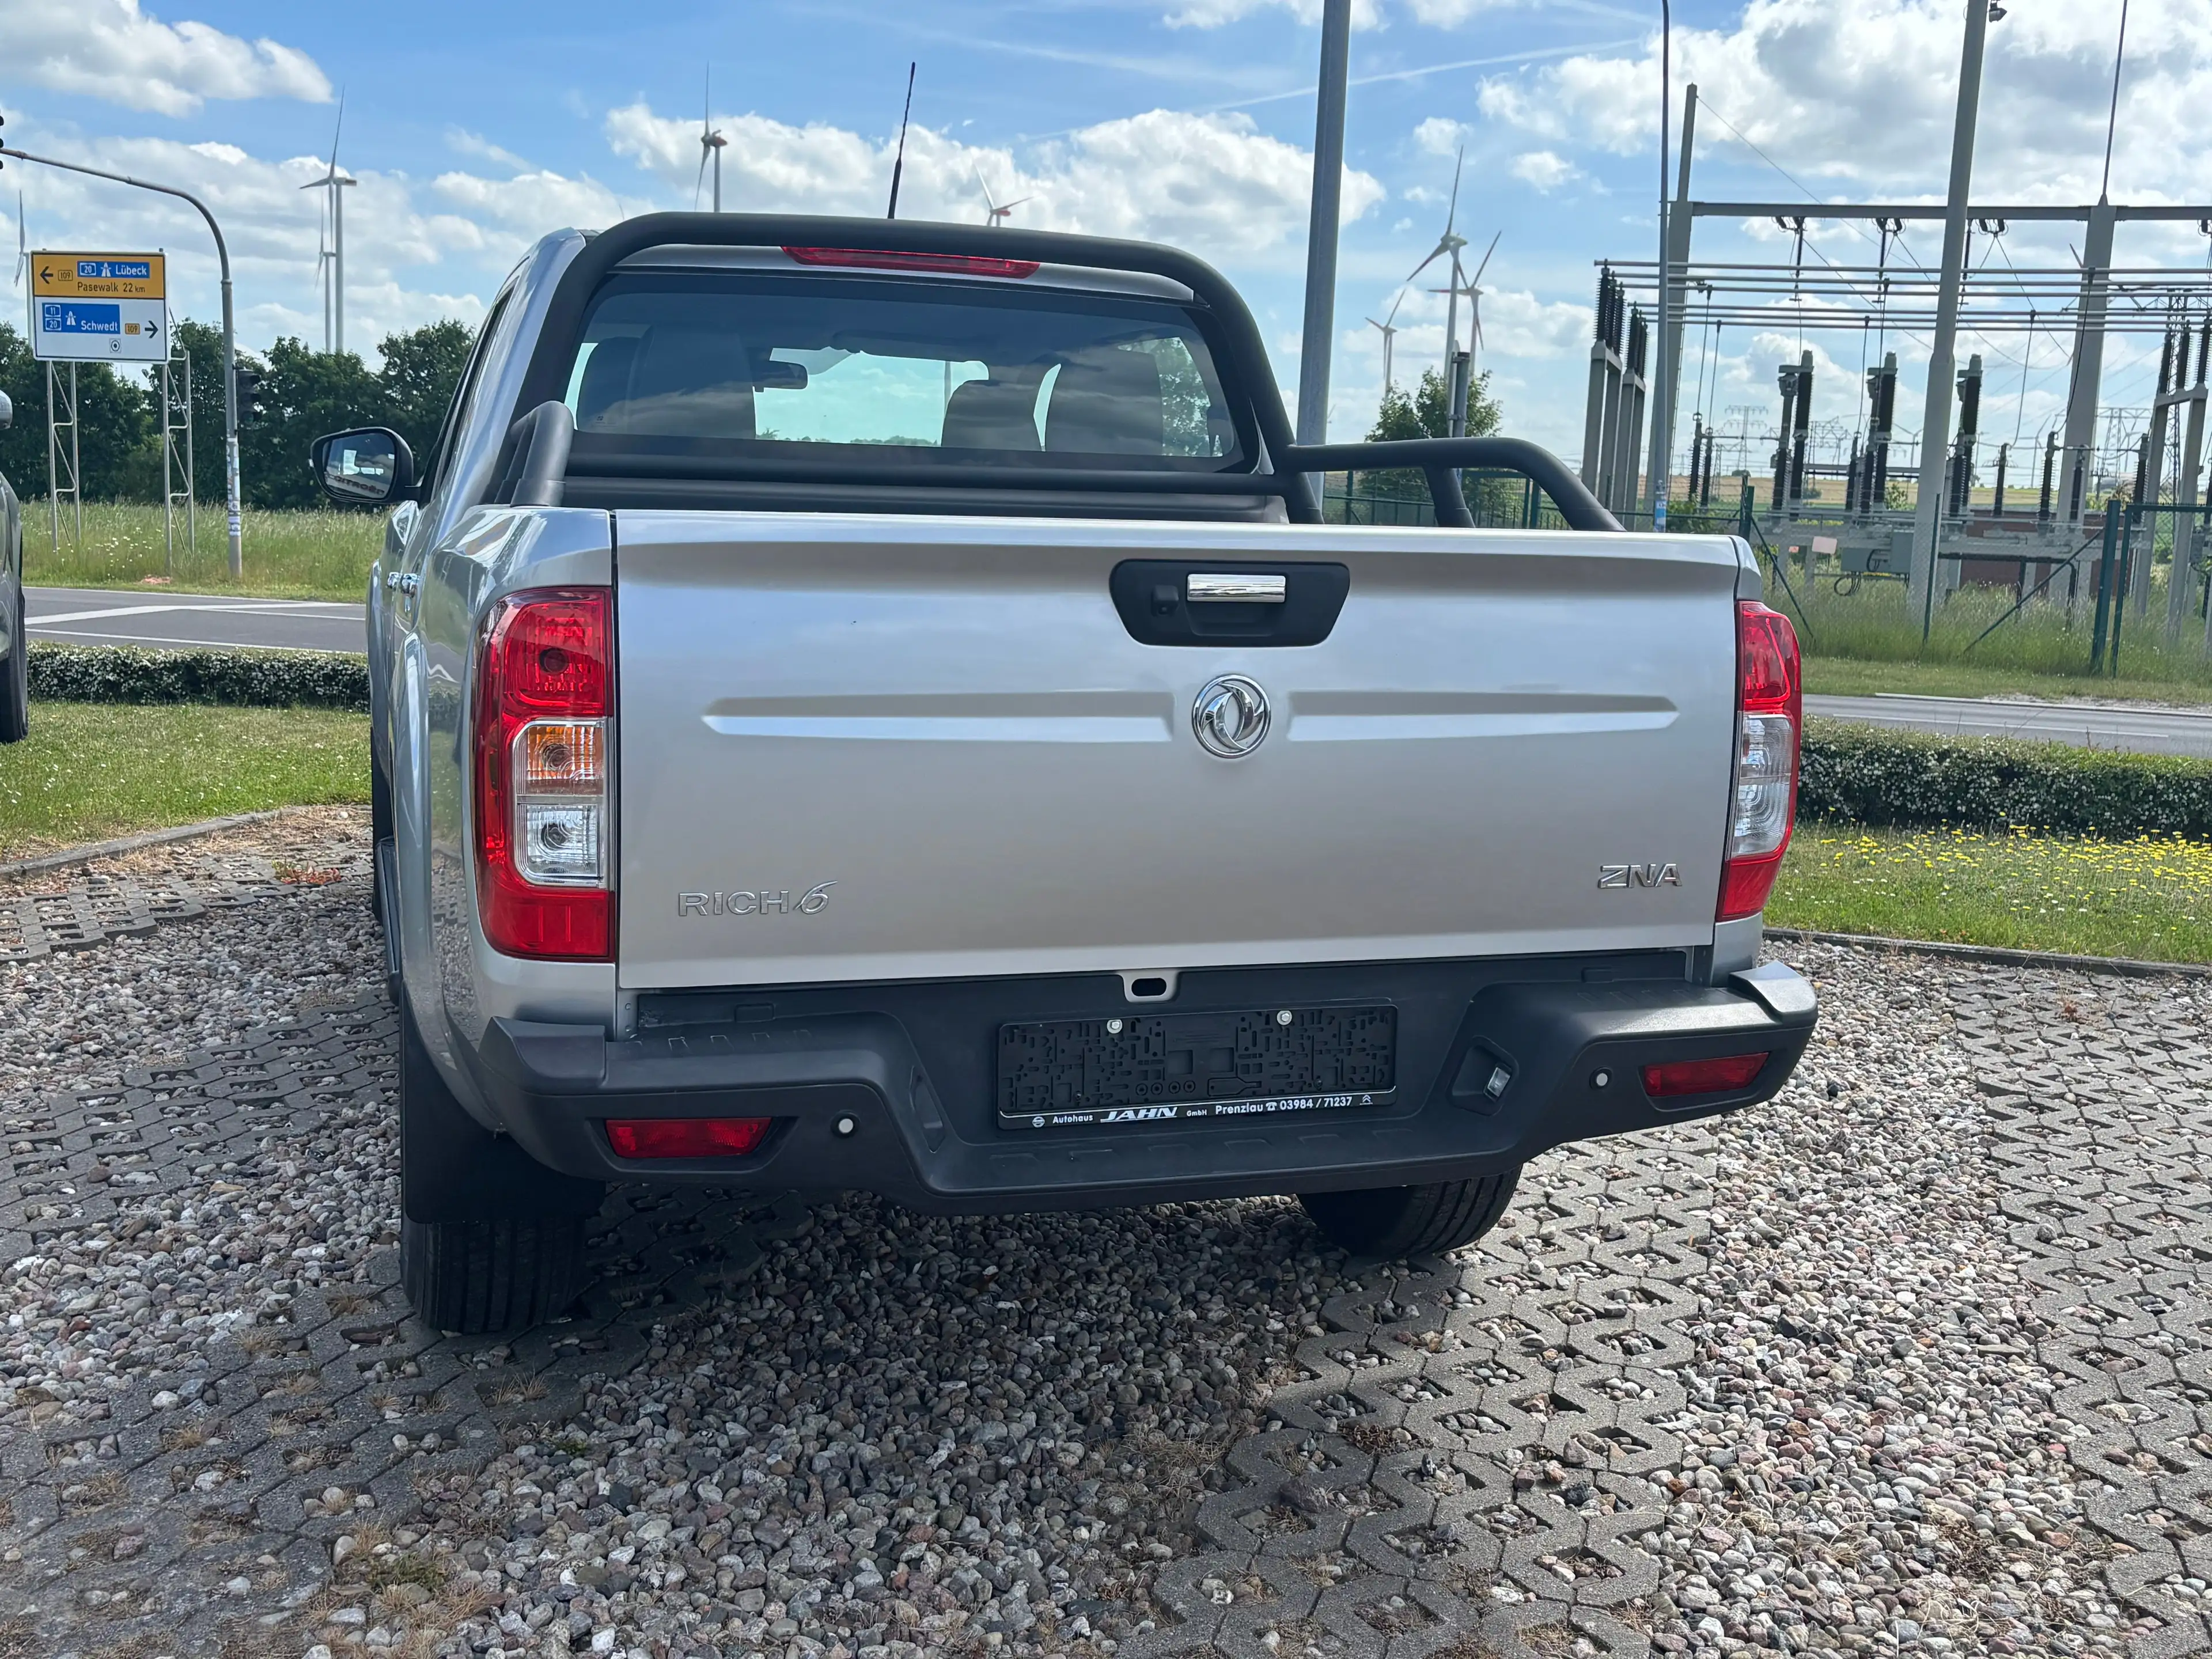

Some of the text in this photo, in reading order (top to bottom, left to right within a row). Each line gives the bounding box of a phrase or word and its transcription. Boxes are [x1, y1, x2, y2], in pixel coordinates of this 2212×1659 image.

[60, 271, 71, 279] 109
[115, 264, 147, 275] Lübeck
[77, 282, 119, 293] Pasewalk
[123, 283, 133, 293] 22
[50, 320, 118, 331] 20 Schwedt
[127, 325, 138, 333] 109
[1597, 863, 1683, 888] ZNA
[1052, 1114, 1093, 1124] Autohaus
[1100, 1107, 1177, 1123] JAHN
[1186, 1109, 1207, 1117] GmbH
[1215, 1103, 1263, 1115] Prenzlau
[1279, 1098, 1314, 1111] 03984
[1323, 1096, 1353, 1107] 71237
